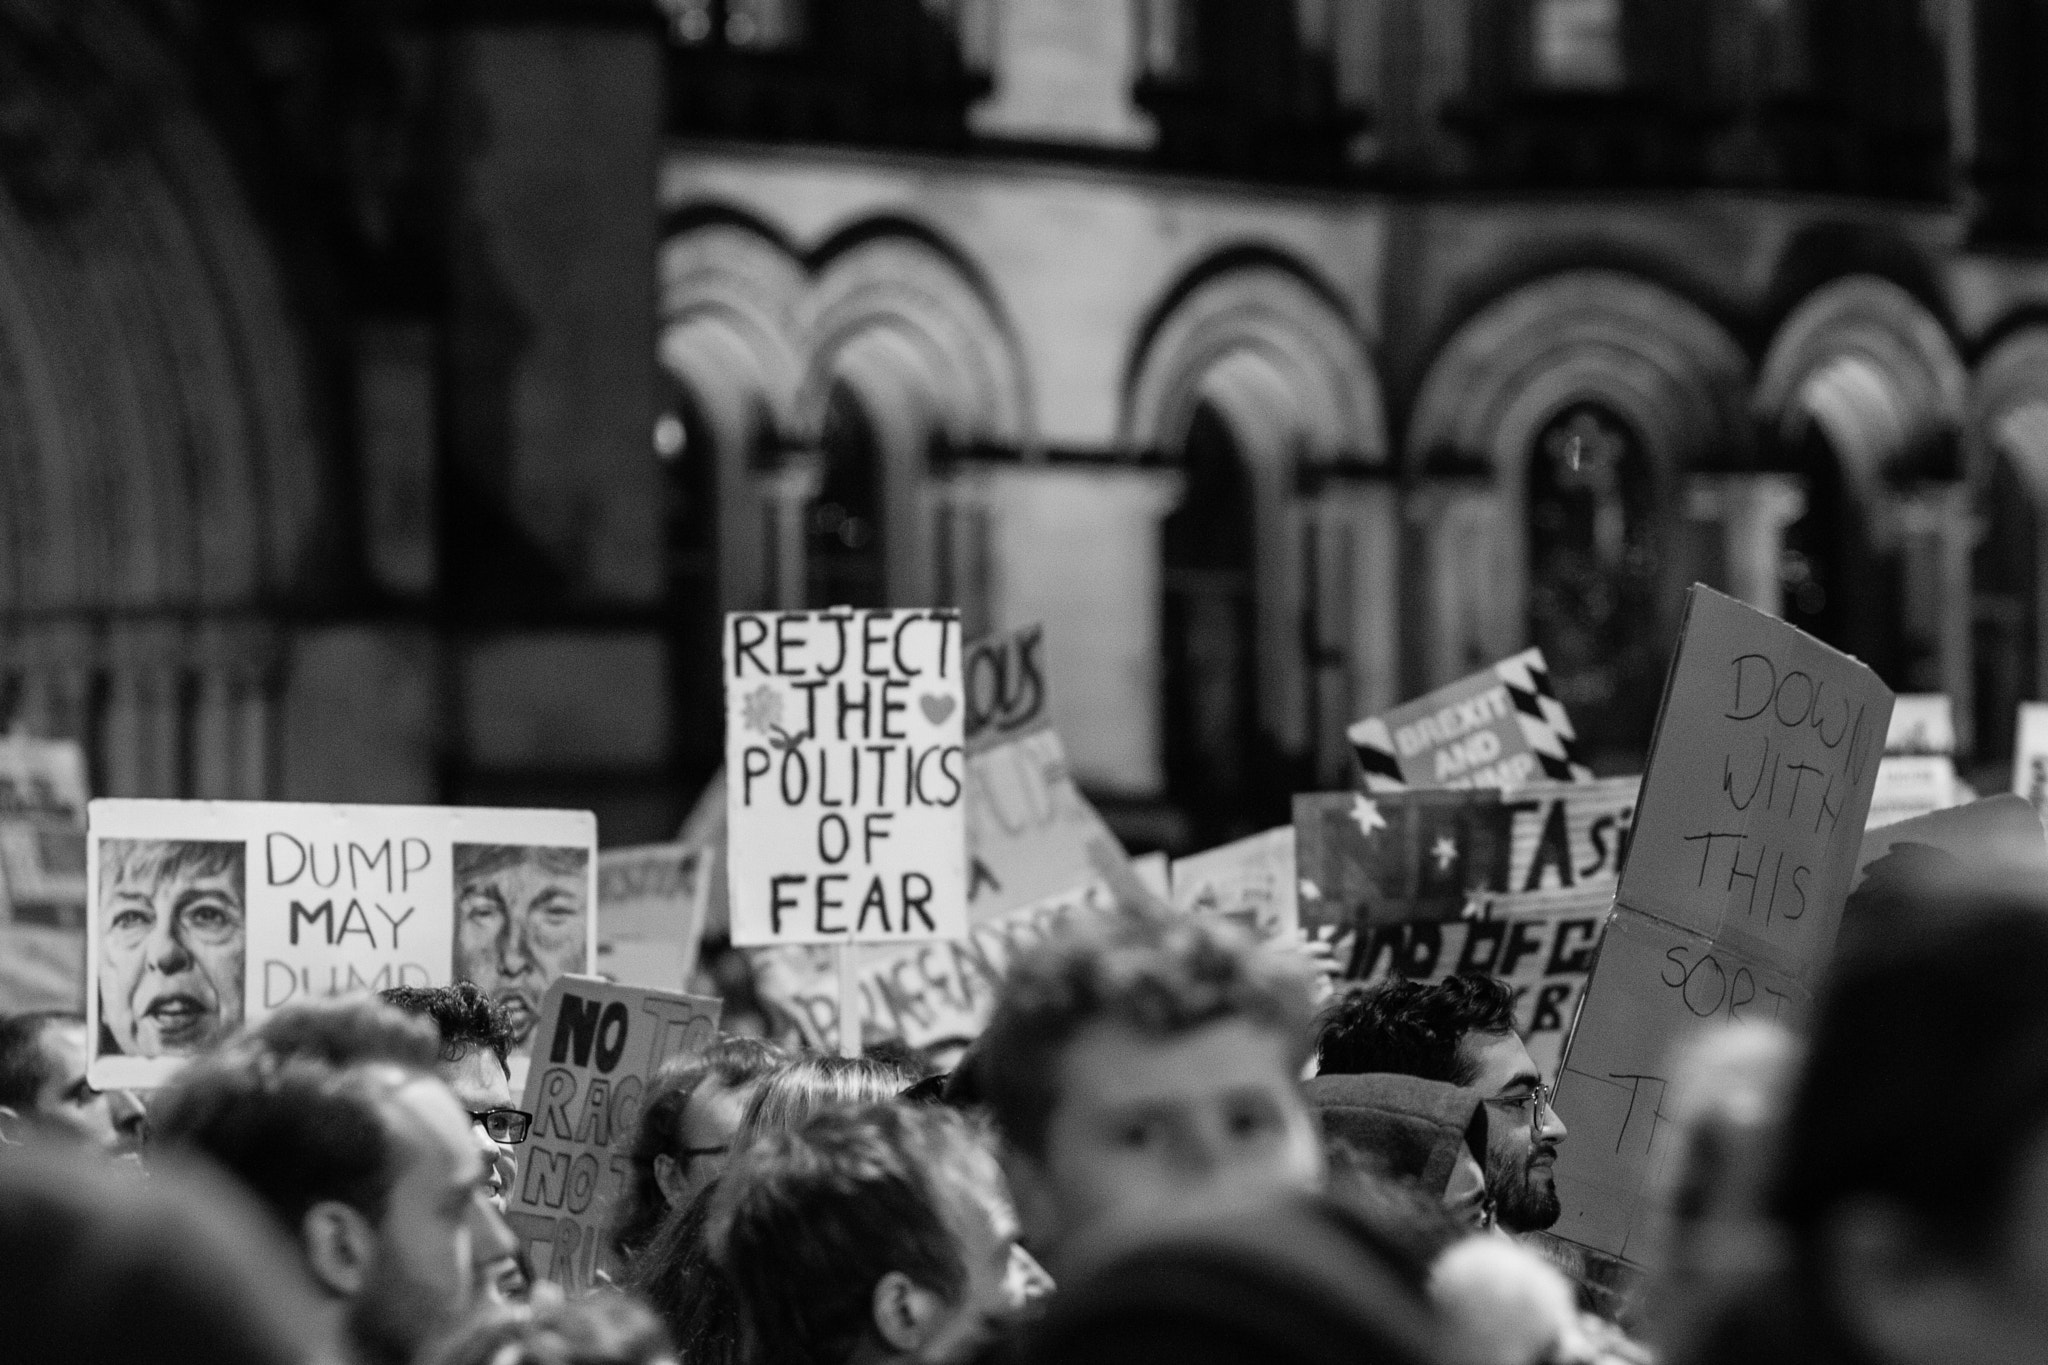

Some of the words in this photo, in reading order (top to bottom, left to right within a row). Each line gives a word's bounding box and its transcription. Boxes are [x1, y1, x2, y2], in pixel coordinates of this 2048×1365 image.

[734, 612, 960, 678] REJECT
[790, 679, 910, 740] THE
[1723, 653, 1872, 786] DOWN
[743, 745, 962, 808] POLITICS
[1434, 730, 1501, 780] AND
[1722, 736, 1846, 834] WITH
[266, 831, 431, 894] DUMP
[817, 811, 894, 866] OF
[770, 871, 936, 934] FEAR
[1684, 832, 1811, 927] THIS
[289, 897, 415, 949] MAY
[263, 958, 431, 1010] DUMP
[1661, 946, 1789, 1025] SORT
[550, 993, 629, 1075] NO
